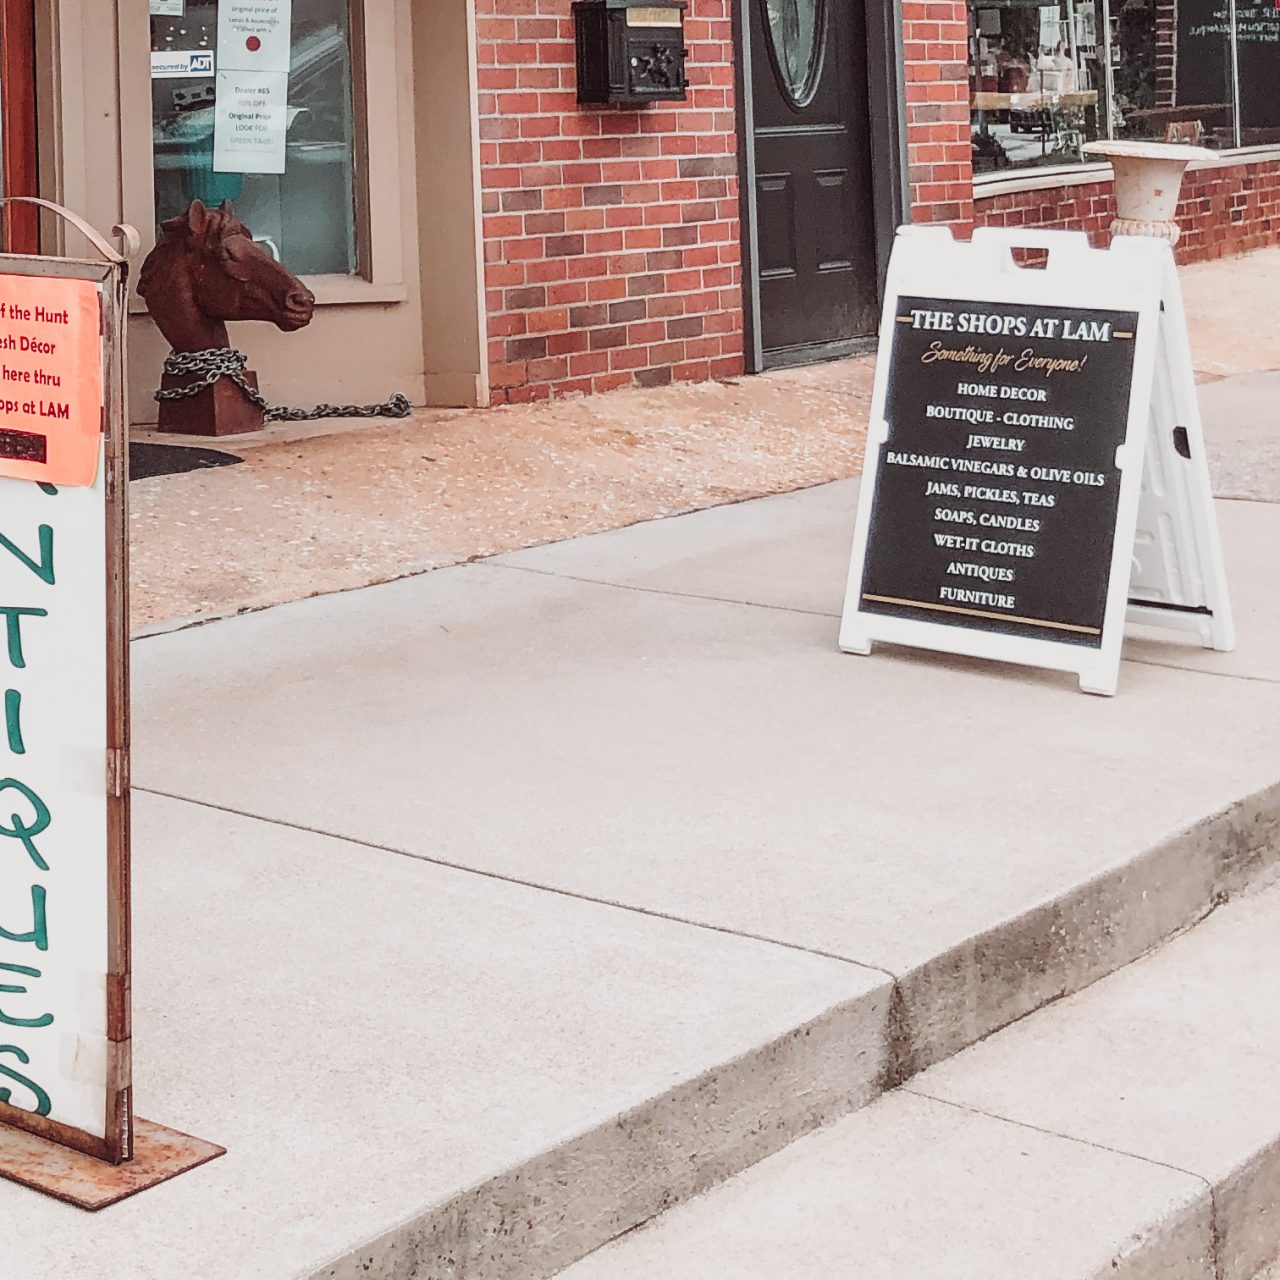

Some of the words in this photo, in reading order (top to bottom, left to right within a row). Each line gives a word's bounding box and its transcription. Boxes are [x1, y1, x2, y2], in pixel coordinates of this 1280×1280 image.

[190, 56, 212, 70] ADT
[234, 86, 256, 94] Dealer
[9, 304, 31, 321] the
[35, 306, 69, 324] Hunt
[910, 309, 954, 331] THE
[957, 313, 1026, 338] SHOPS
[1028, 318, 1060, 339] AT
[1062, 320, 1112, 342] LAM
[20, 335, 56, 355] Décor
[921, 340, 993, 372] Something
[990, 351, 1012, 373] for
[1014, 348, 1088, 377] Everyone!
[3, 365, 30, 382] here
[34, 369, 61, 387] thru
[957, 382, 998, 398] HOME
[1000, 387, 1047, 402] DECOR
[22, 400, 36, 413] at
[39, 401, 70, 420] LAM
[925, 405, 994, 424] BOUTIQUE
[1003, 412, 1074, 431] CLOTHING
[966, 434, 1025, 452] JEWELRY
[886, 451, 949, 470] BALSAMIC
[951, 458, 1015, 478] VINEGARS
[1016, 466, 1028, 478] &
[1030, 466, 1071, 484] OLIVE
[1074, 471, 1105, 487] OILS
[925, 480, 961, 499] JAMS,
[963, 486, 1020, 505] PICKLES,
[1022, 491, 1055, 508] TEAS
[934, 507, 977, 526] SOAPS,
[979, 513, 1040, 532] CANDLES
[933, 533, 979, 552] WET-IT
[981, 539, 1034, 558] CLOTHS
[946, 562, 1014, 582] ANTIQUES
[939, 586, 1016, 609] FURNITURE
